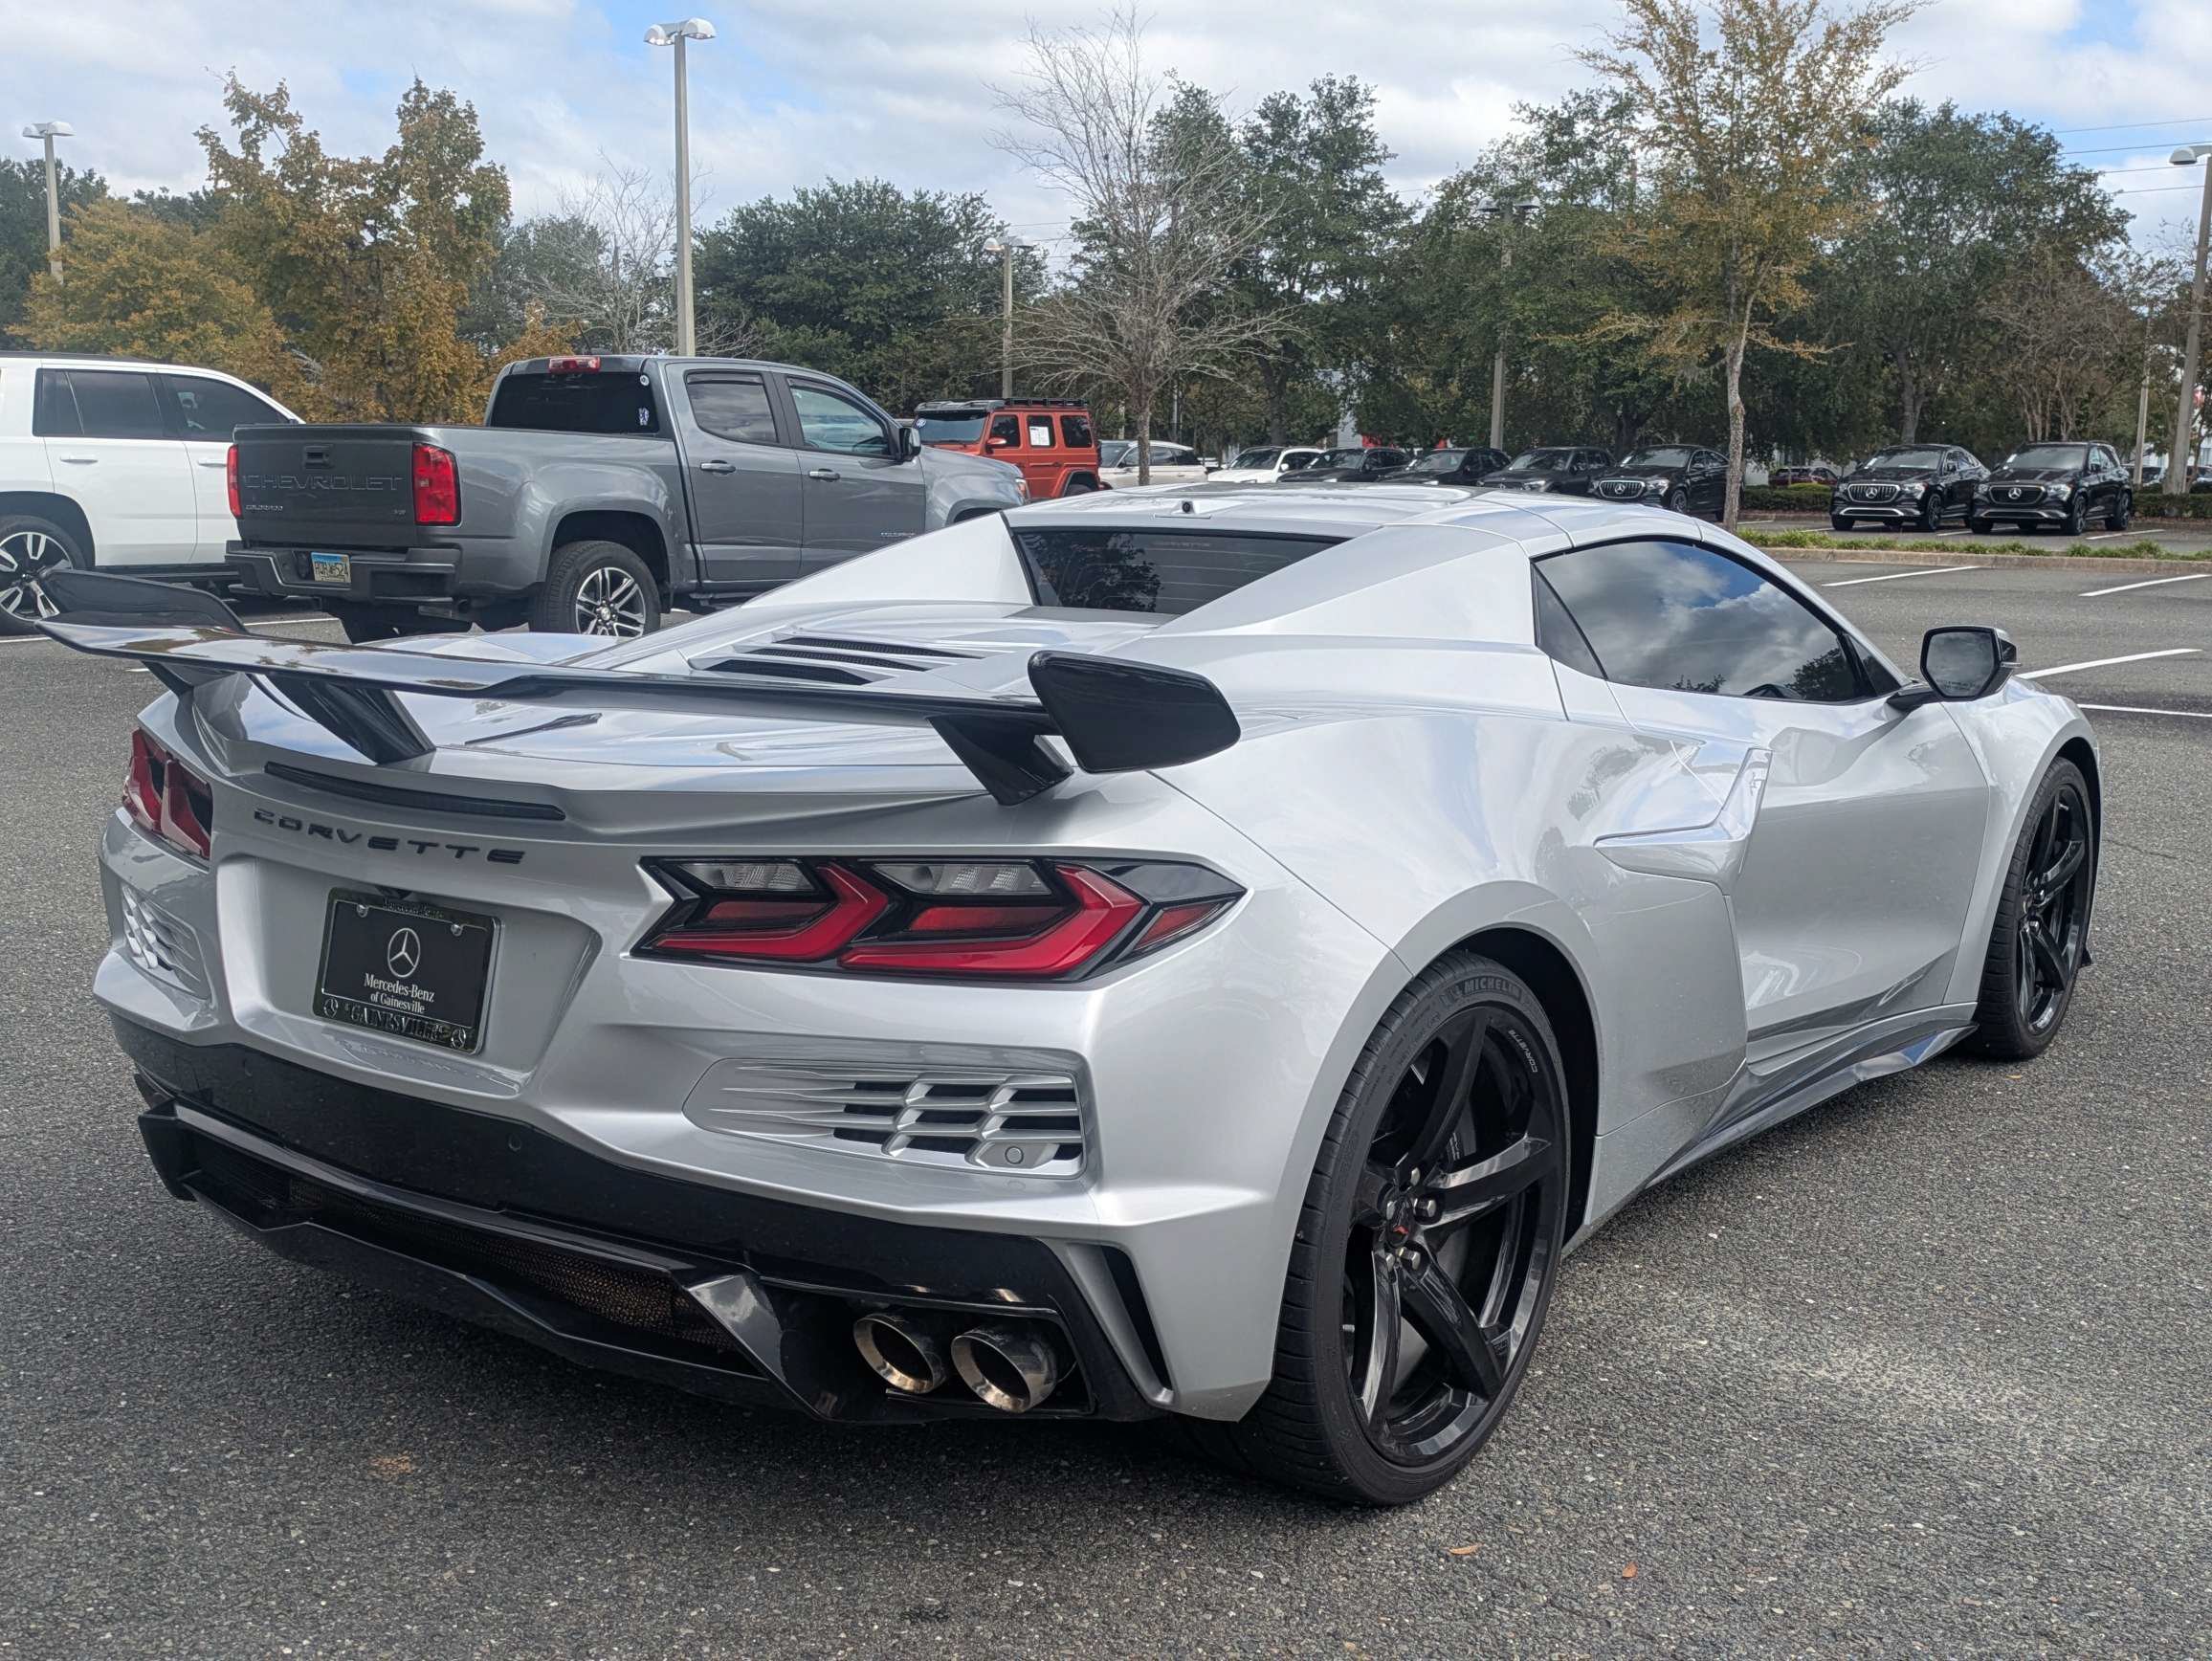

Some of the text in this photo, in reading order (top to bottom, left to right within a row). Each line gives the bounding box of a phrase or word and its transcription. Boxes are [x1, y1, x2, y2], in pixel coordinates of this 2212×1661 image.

[242, 475, 404, 491] CHEVROLET
[254, 808, 525, 865] CORVETTE
[364, 972, 435, 1003] Mercedes-Benz
[1463, 976, 1521, 1002] MICHELIN
[370, 991, 425, 1014] of Gainesville
[1508, 1029, 1538, 1073] CORVETTE
